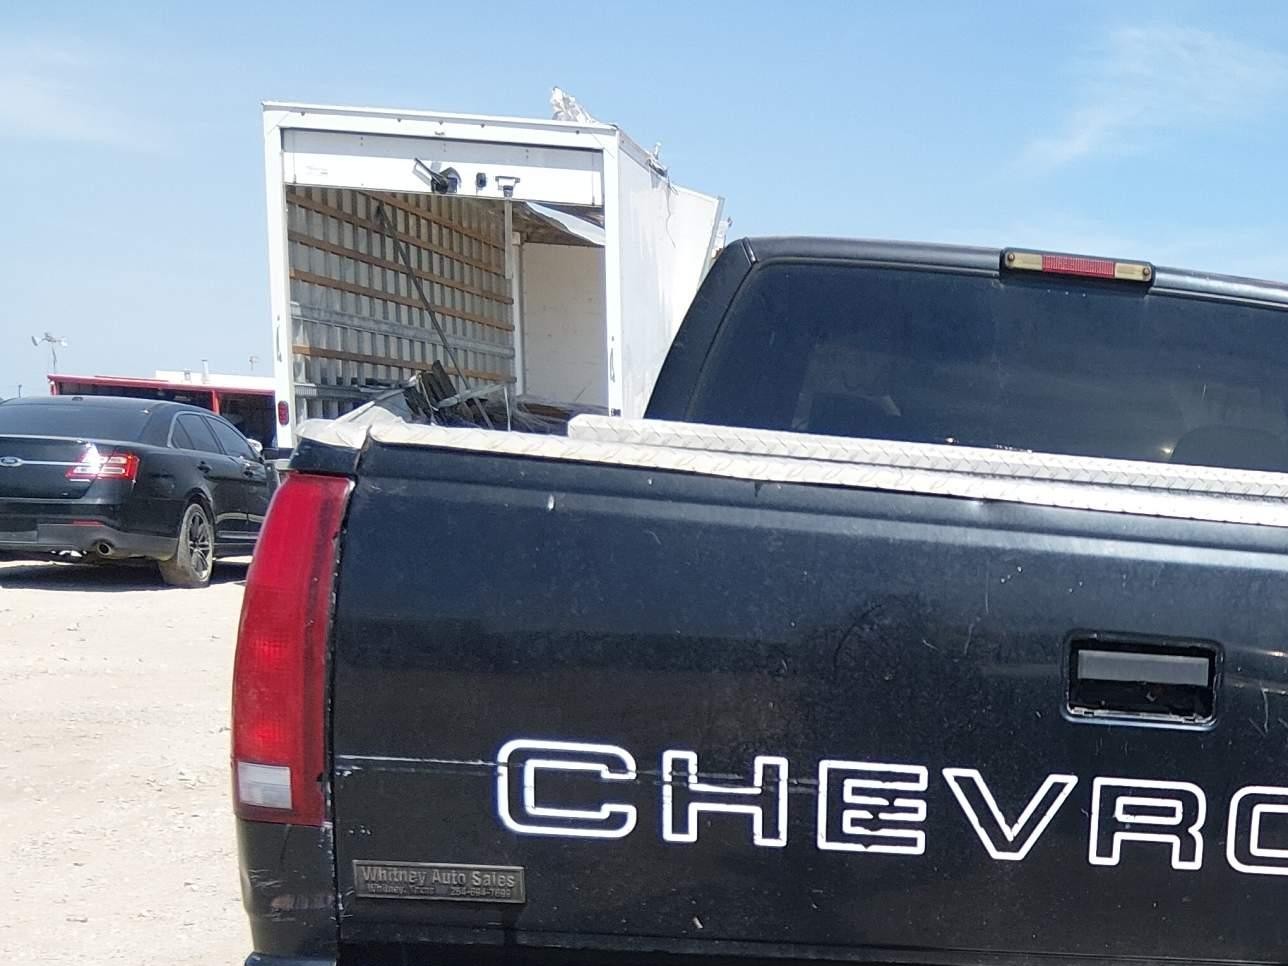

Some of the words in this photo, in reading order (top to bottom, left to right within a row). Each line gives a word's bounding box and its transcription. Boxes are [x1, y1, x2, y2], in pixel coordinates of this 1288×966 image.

[361, 866, 427, 885] Whitney
[431, 868, 467, 886] Auto
[471, 870, 515, 888] Sales
